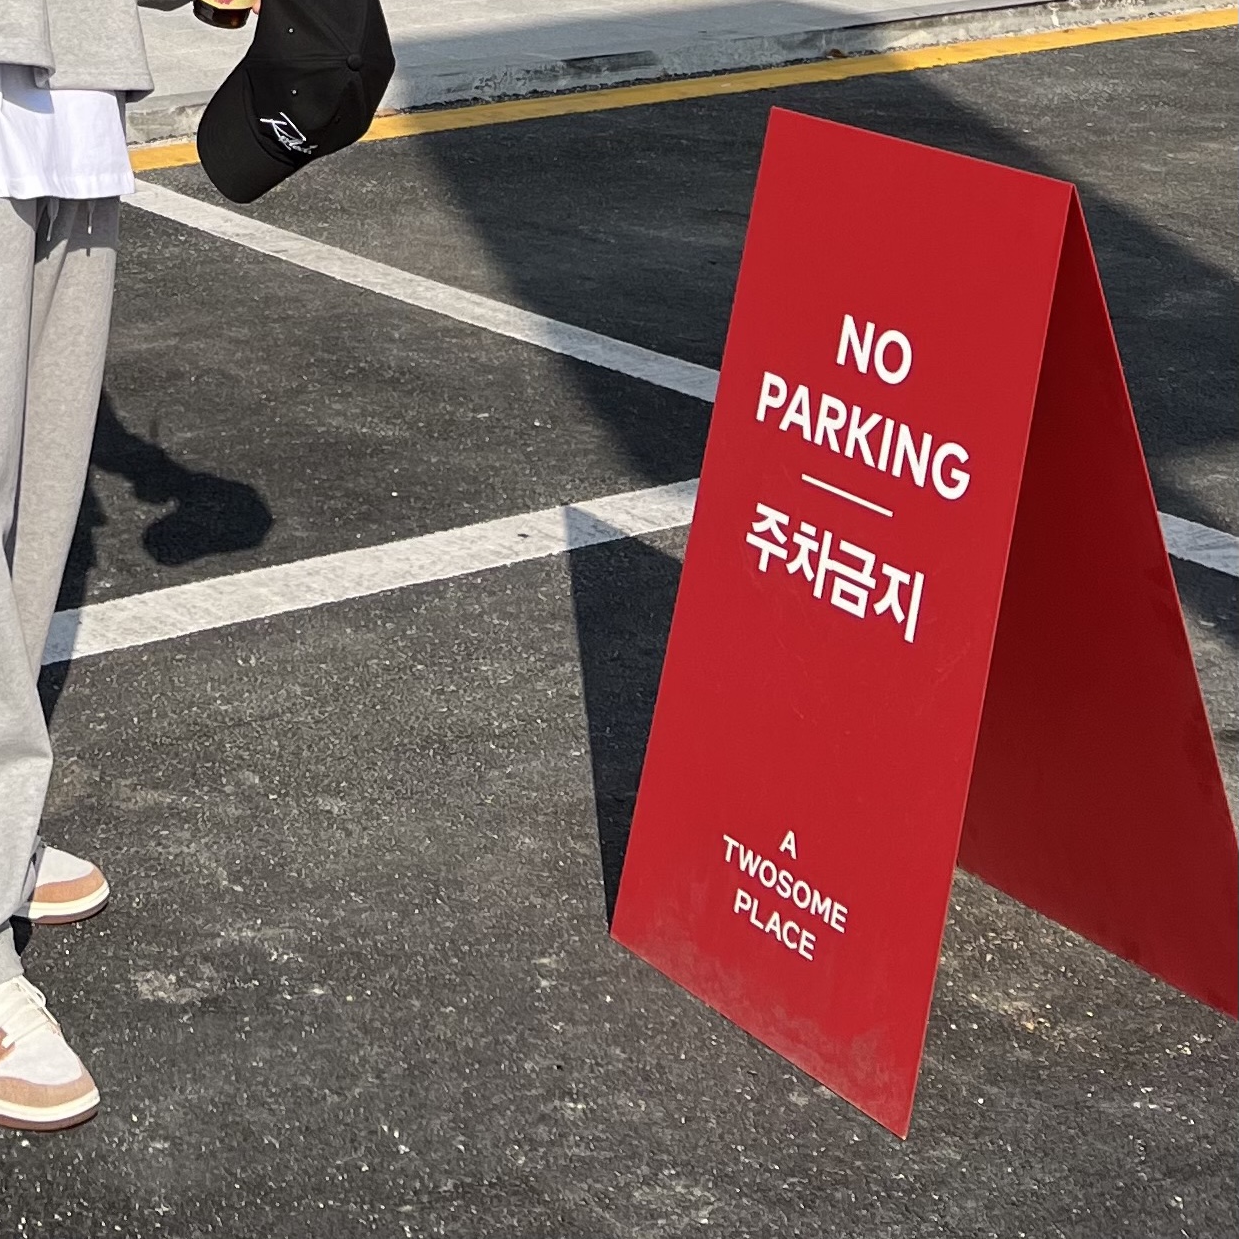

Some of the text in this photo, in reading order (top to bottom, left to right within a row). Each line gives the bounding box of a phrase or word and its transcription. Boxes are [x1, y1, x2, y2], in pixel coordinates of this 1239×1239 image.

[836, 313, 913, 386] NO
[755, 371, 971, 501] PARKING
[745, 502, 925, 644] 주차금지
[722, 835, 848, 934] TWOSOME
[779, 830, 797, 860] A
[733, 888, 817, 961] PLACE
